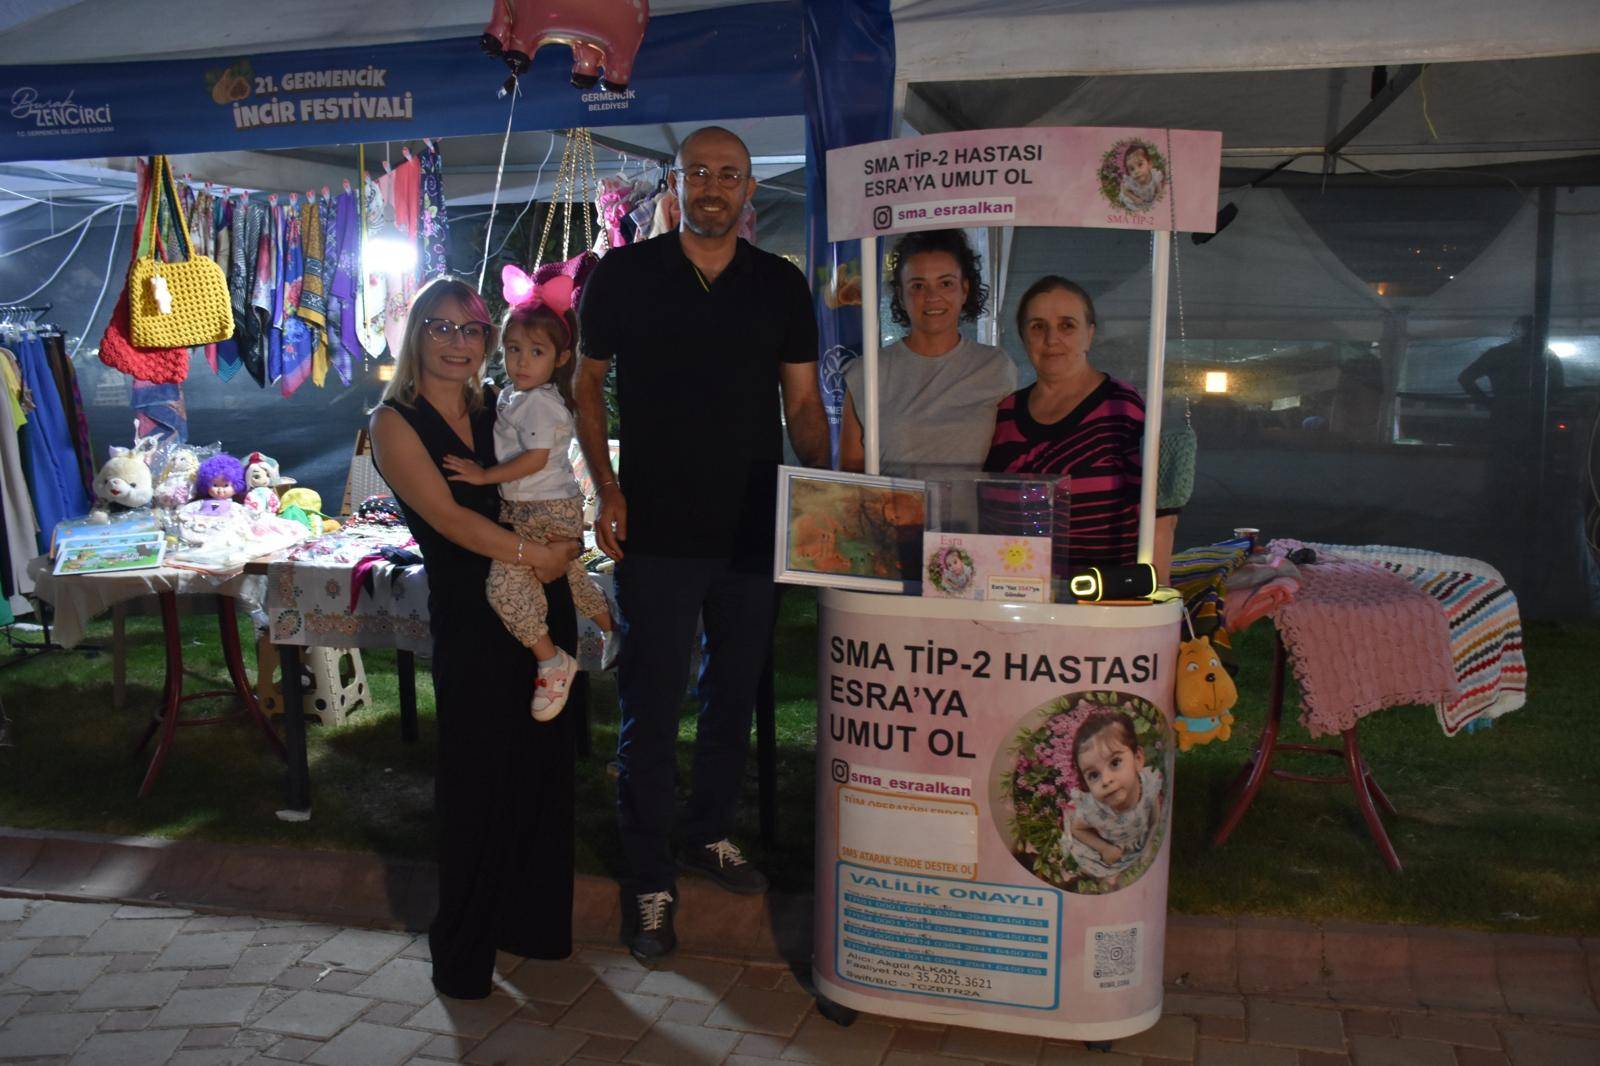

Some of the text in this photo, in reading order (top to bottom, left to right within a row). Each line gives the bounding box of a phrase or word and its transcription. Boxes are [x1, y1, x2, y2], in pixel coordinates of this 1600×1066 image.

[254, 65, 387, 94] 21. GERMENCİK
[233, 91, 413, 129] İNCİR FESTİVALİ
[864, 145, 1042, 175] SMA TİP-2 HASTASI
[864, 168, 1033, 198] ESRA'YA UMUT OL
[898, 201, 1013, 220] sma_esraalkan
[940, 535, 963, 546] Esra
[830, 636, 1158, 685] SMA TİP-2 HASTASI
[830, 714, 917, 753] UMUT
[928, 729, 976, 759] OL
[850, 772, 971, 797] sma_esraalkan
[859, 850, 892, 865] ATARAK
[894, 857, 923, 869] SENDE
[925, 860, 958, 874] DESTEK
[960, 864, 973, 875] OL
[850, 872, 941, 896] VALİLİK
[949, 887, 1043, 907] ONAYLI
[846, 959, 890, 975] Faaliyet
[916, 971, 993, 989] 35.2025.3621
[877, 958, 910, 970] Akgül
[913, 964, 958, 975] ALKAN
[910, 982, 981, 997] TCZBTR2A
